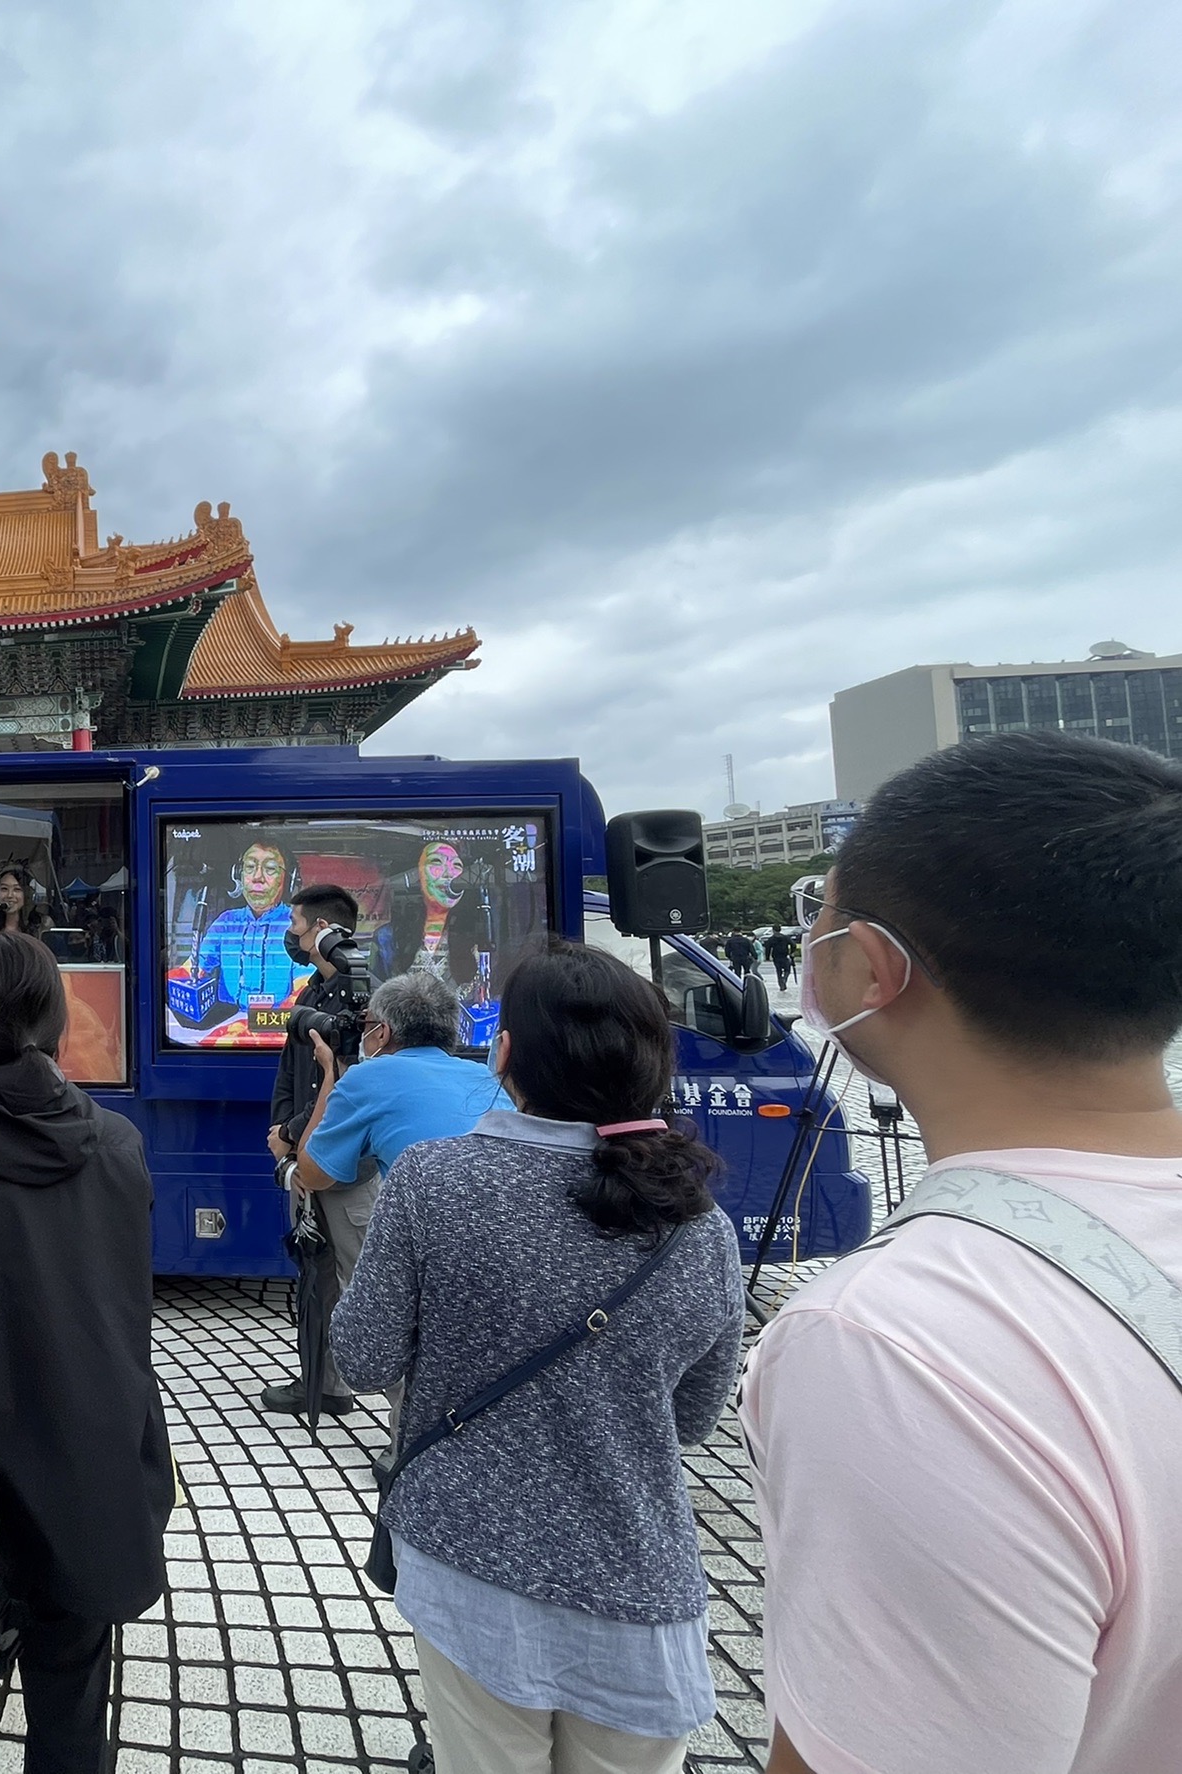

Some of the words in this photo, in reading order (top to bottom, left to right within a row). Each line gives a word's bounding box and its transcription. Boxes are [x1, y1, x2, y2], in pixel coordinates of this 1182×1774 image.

[670, 1082, 752, 1107] 基金會
[708, 1108, 753, 1116] FOUNDATION
